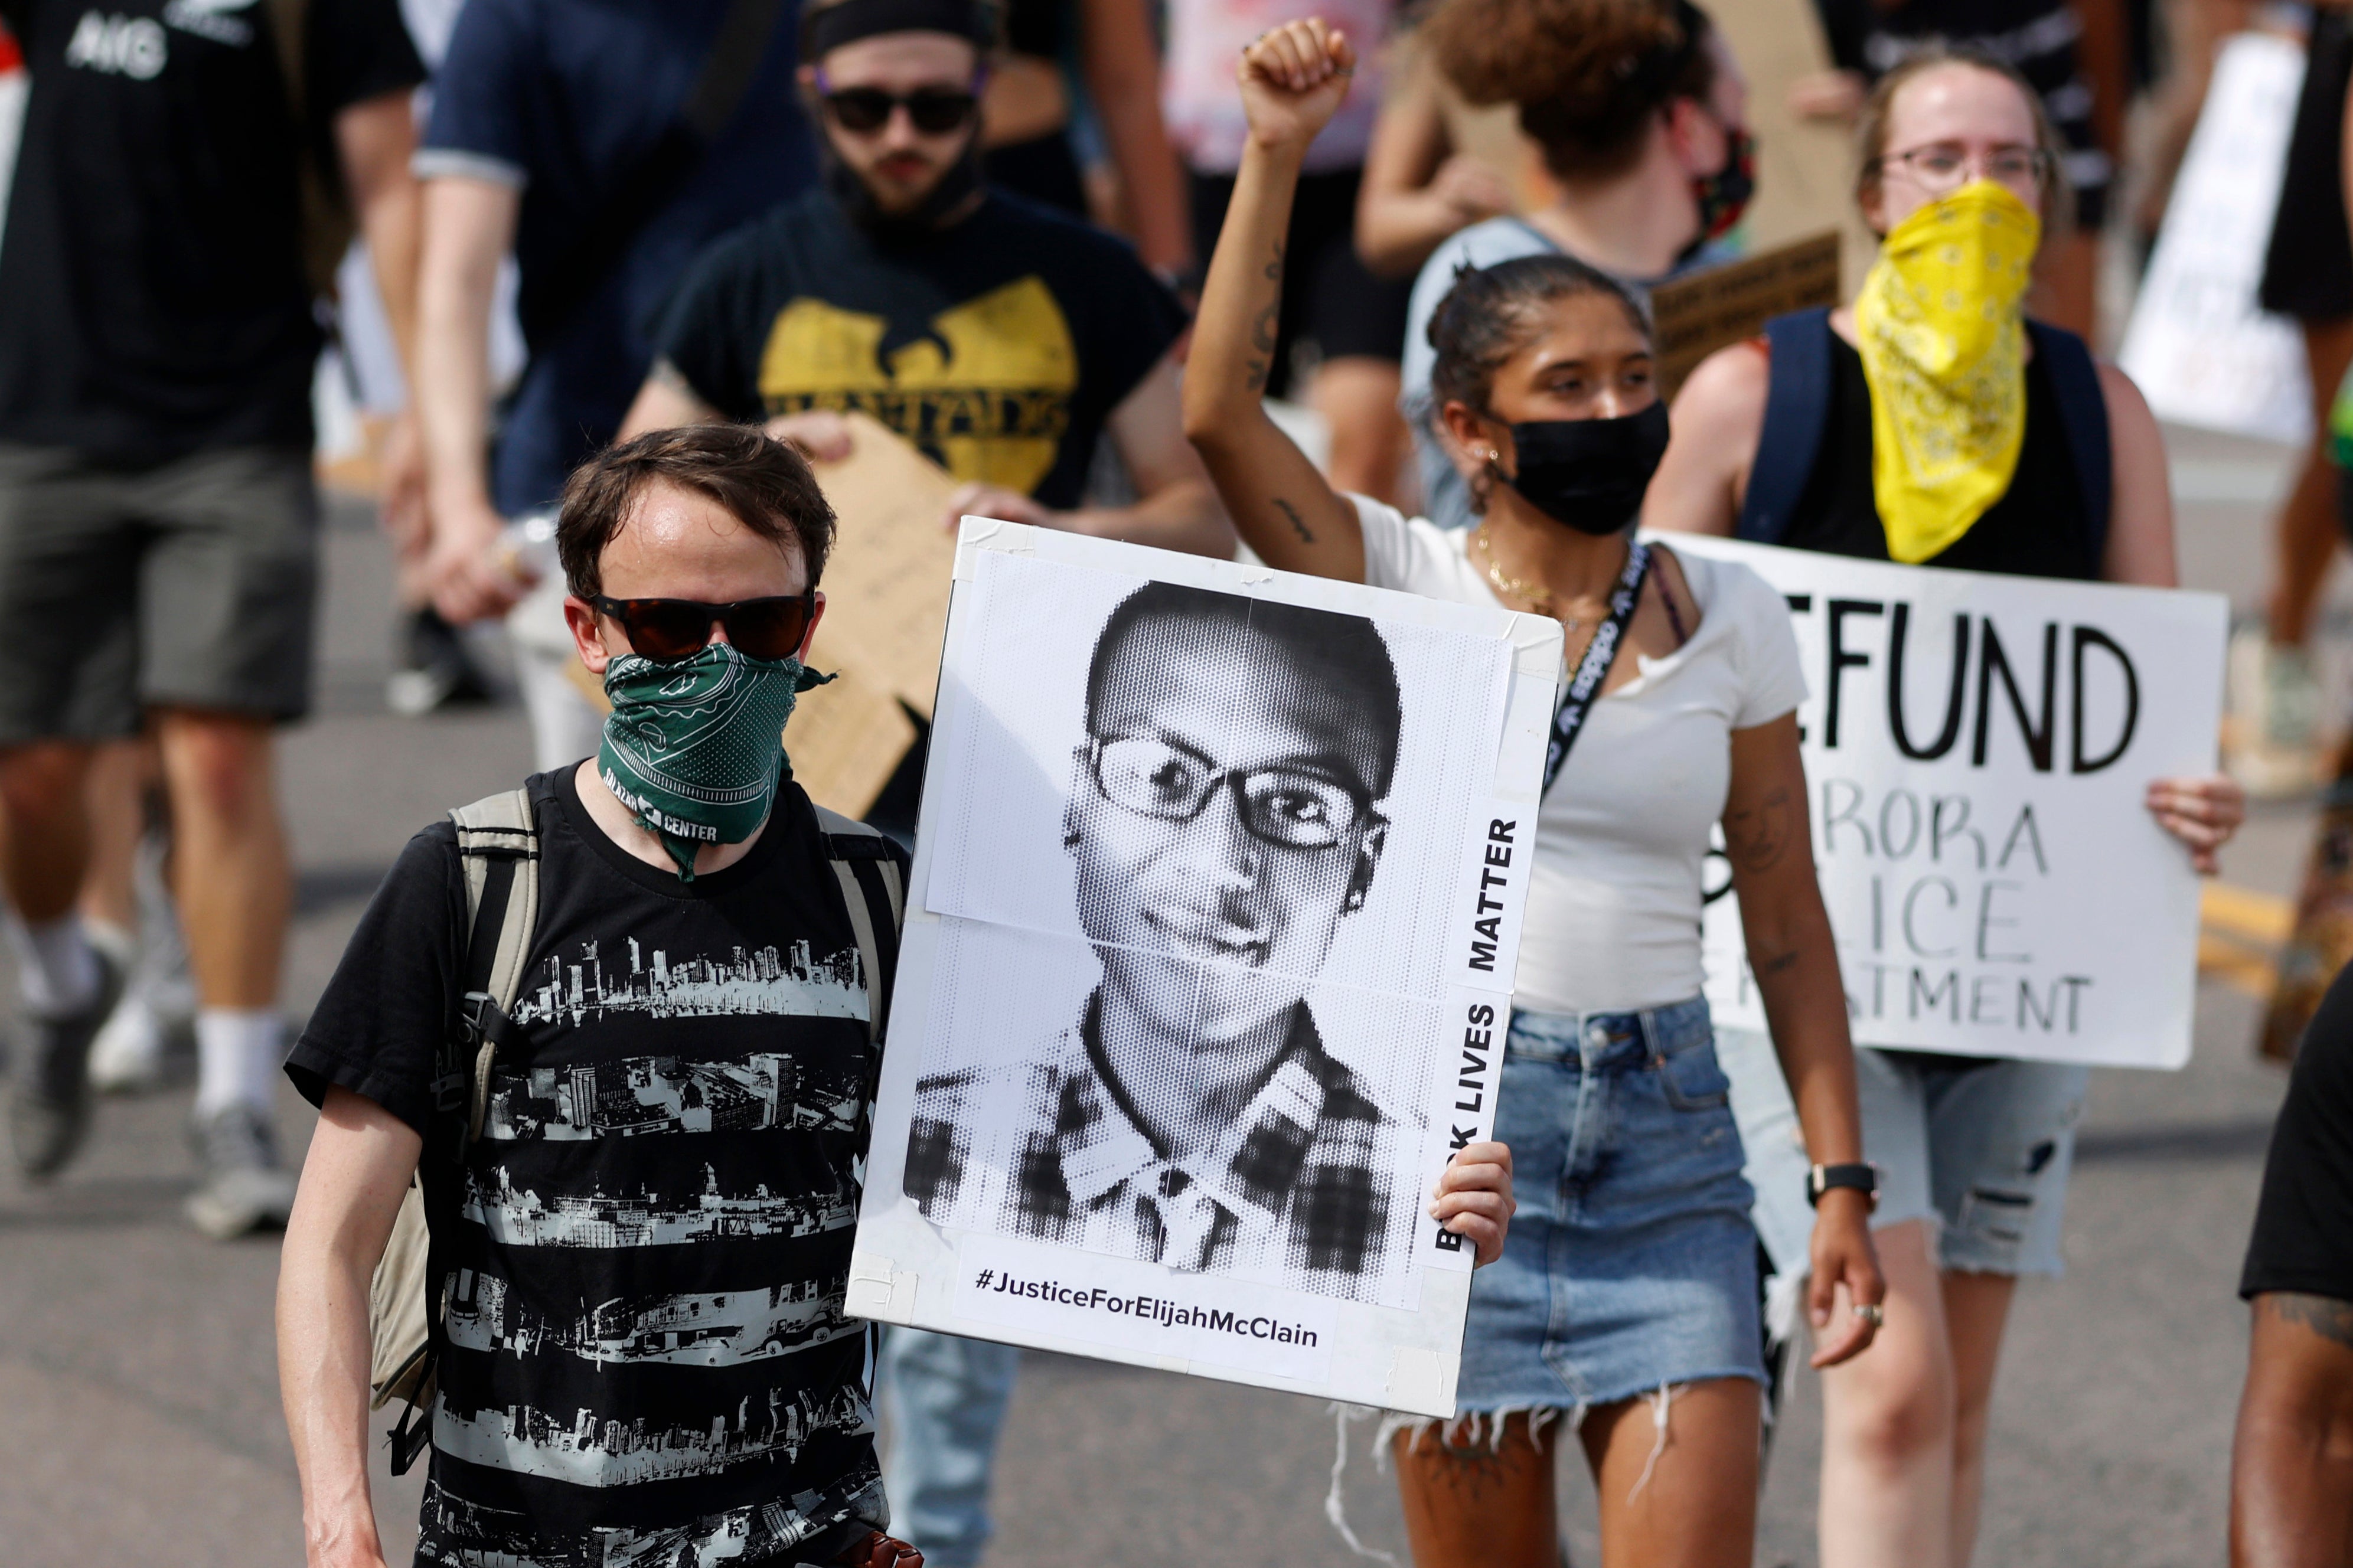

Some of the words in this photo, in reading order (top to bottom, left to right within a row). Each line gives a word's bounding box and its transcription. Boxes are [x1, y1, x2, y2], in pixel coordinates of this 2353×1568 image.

[65, 10, 168, 80] AIG
[1570, 620, 1620, 702] adidas
[1784, 595, 2140, 773] FUND
[603, 767, 638, 812] SALAZAR
[664, 815, 717, 842] CENTER
[1821, 778, 2048, 876] RORA
[1468, 818, 1516, 972] MATTER
[1836, 874, 2034, 963] ICE
[1455, 1004, 1494, 1113] LIVES
[975, 1269, 1318, 1348] #JusticeForElijahMcClain
